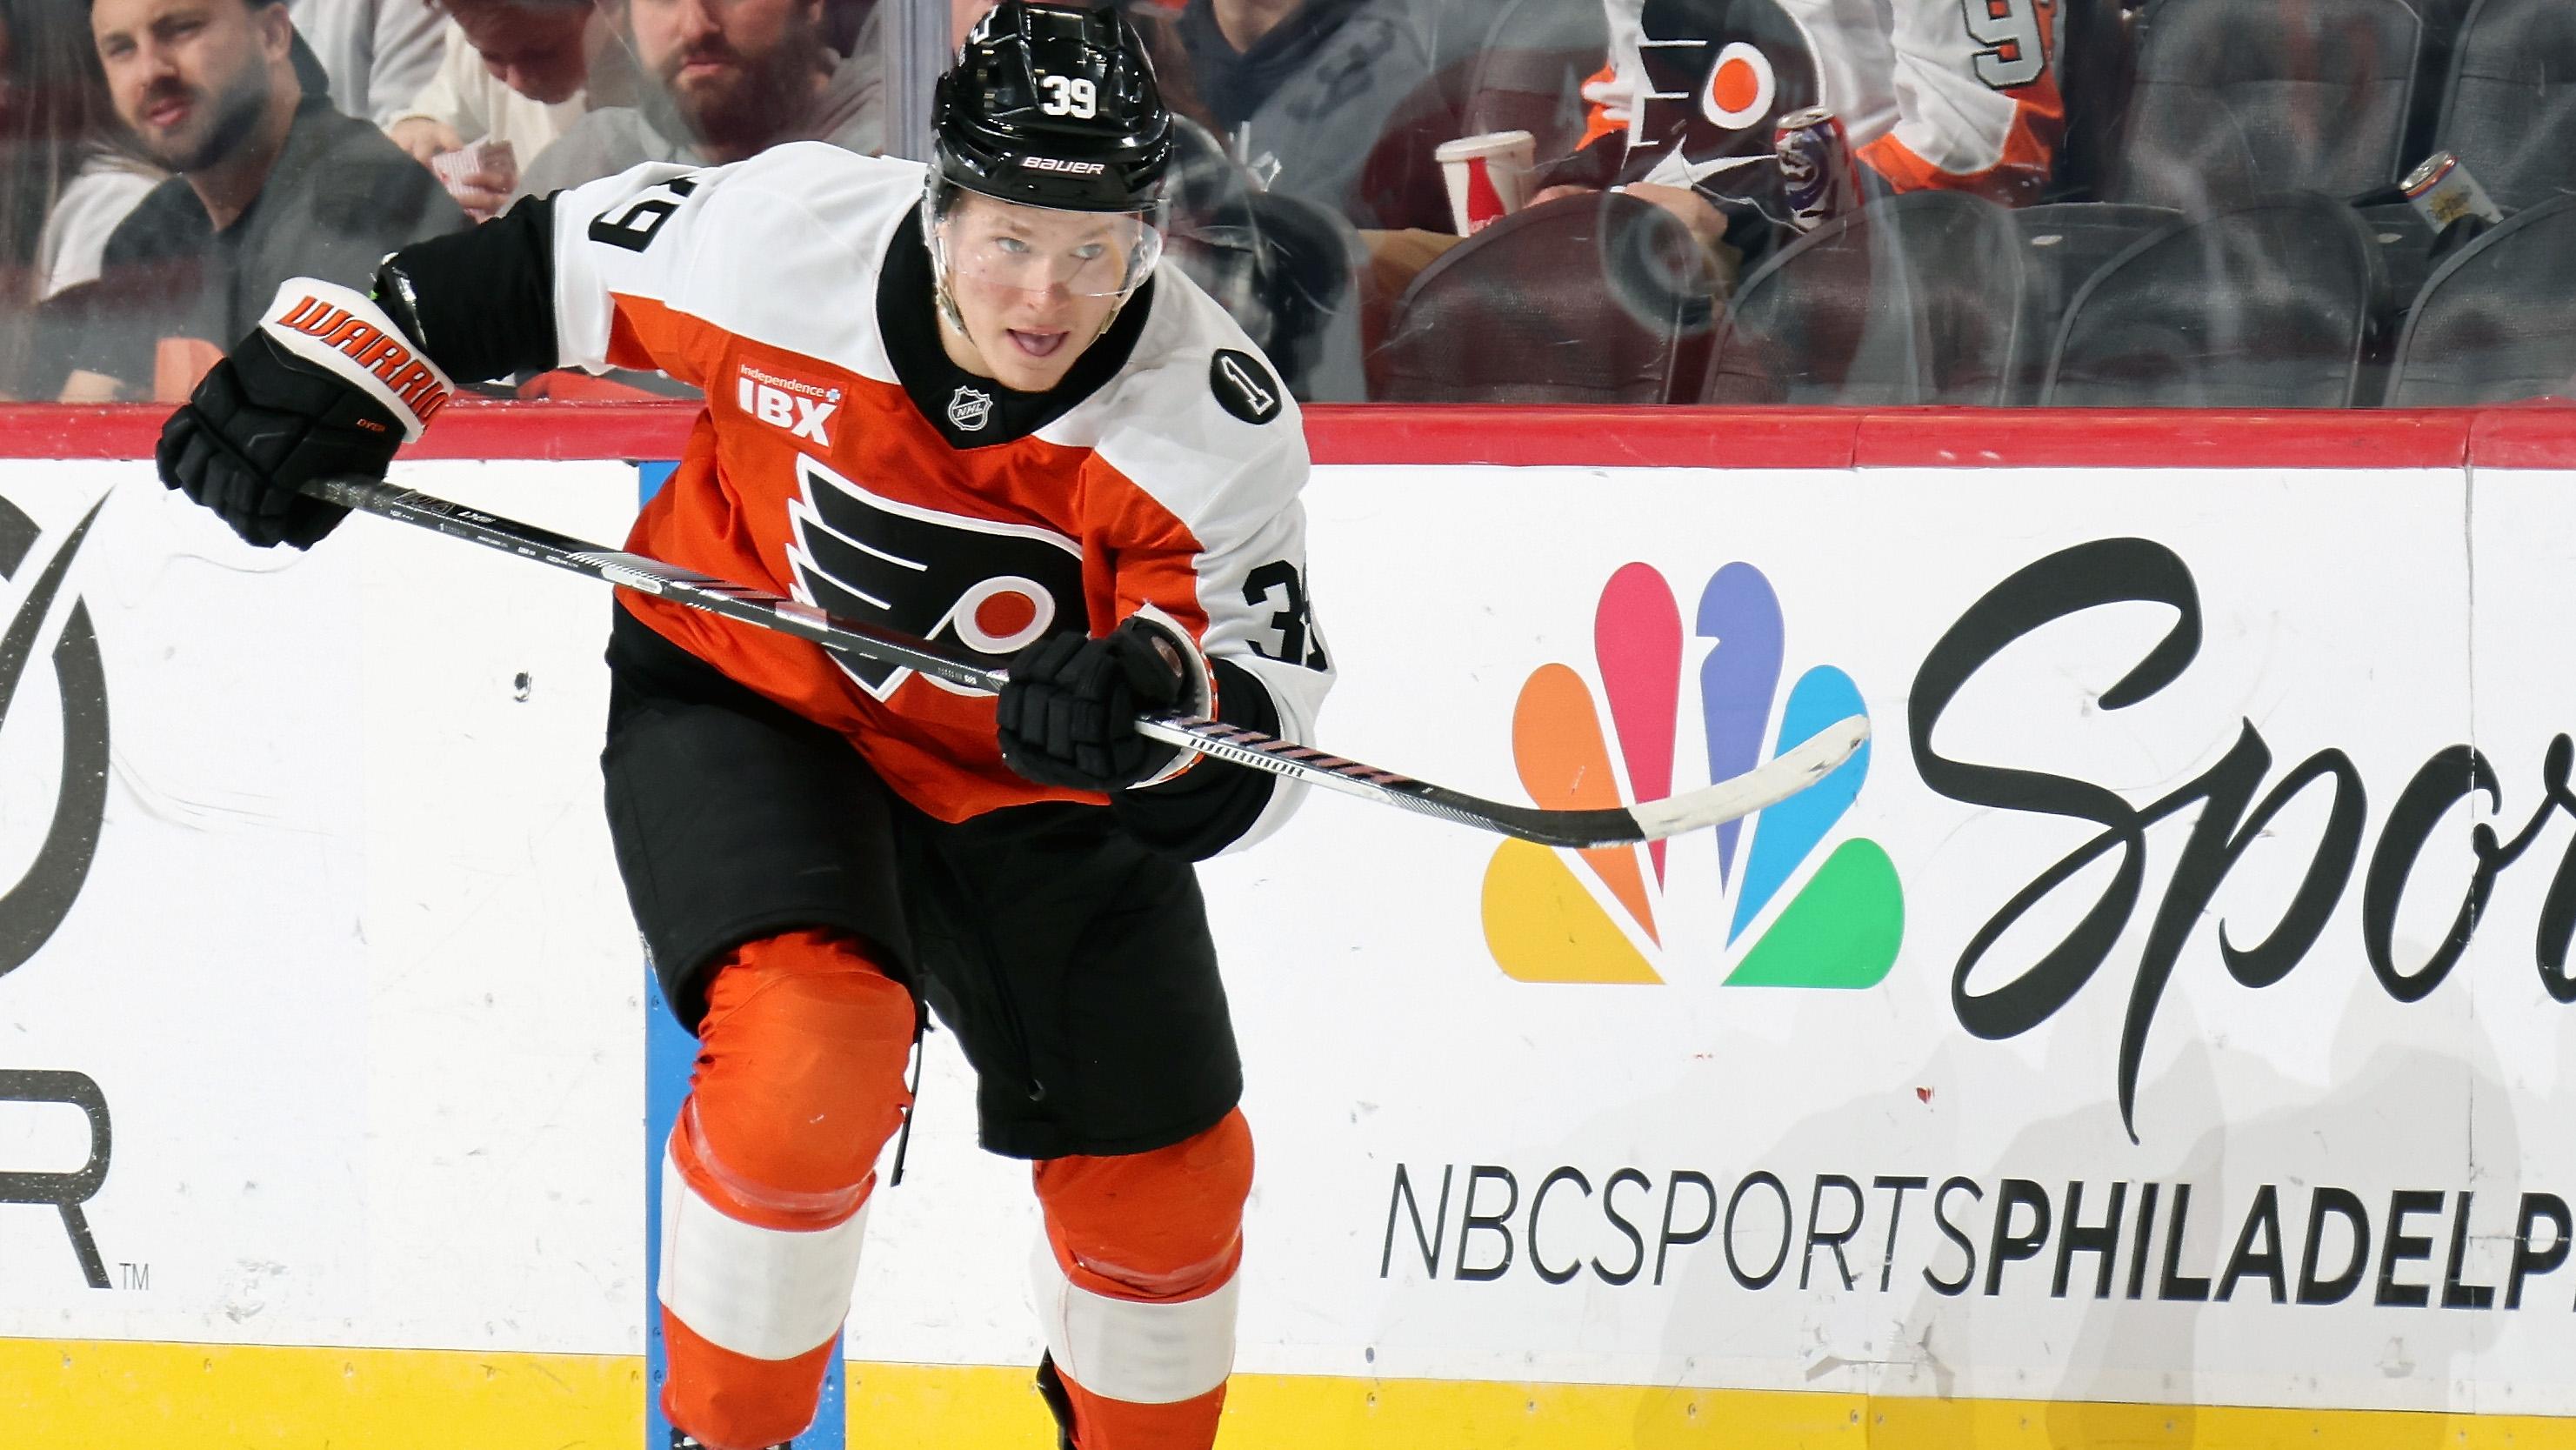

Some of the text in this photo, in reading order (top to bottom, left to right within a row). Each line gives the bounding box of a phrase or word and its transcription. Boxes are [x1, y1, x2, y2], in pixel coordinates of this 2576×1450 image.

[1042, 75, 1097, 119] 39
[1021, 156, 1105, 175] BAUER
[739, 363, 825, 398] Independence
[1221, 355, 1275, 417] 1
[738, 376, 838, 448] IBX
[957, 402, 983, 418] NHL
[1189, 738, 1305, 778] WARRIOR
[1379, 1163, 2576, 1313] NBCSPORTSPHILADELP
[118, 1262, 150, 1291] TM
